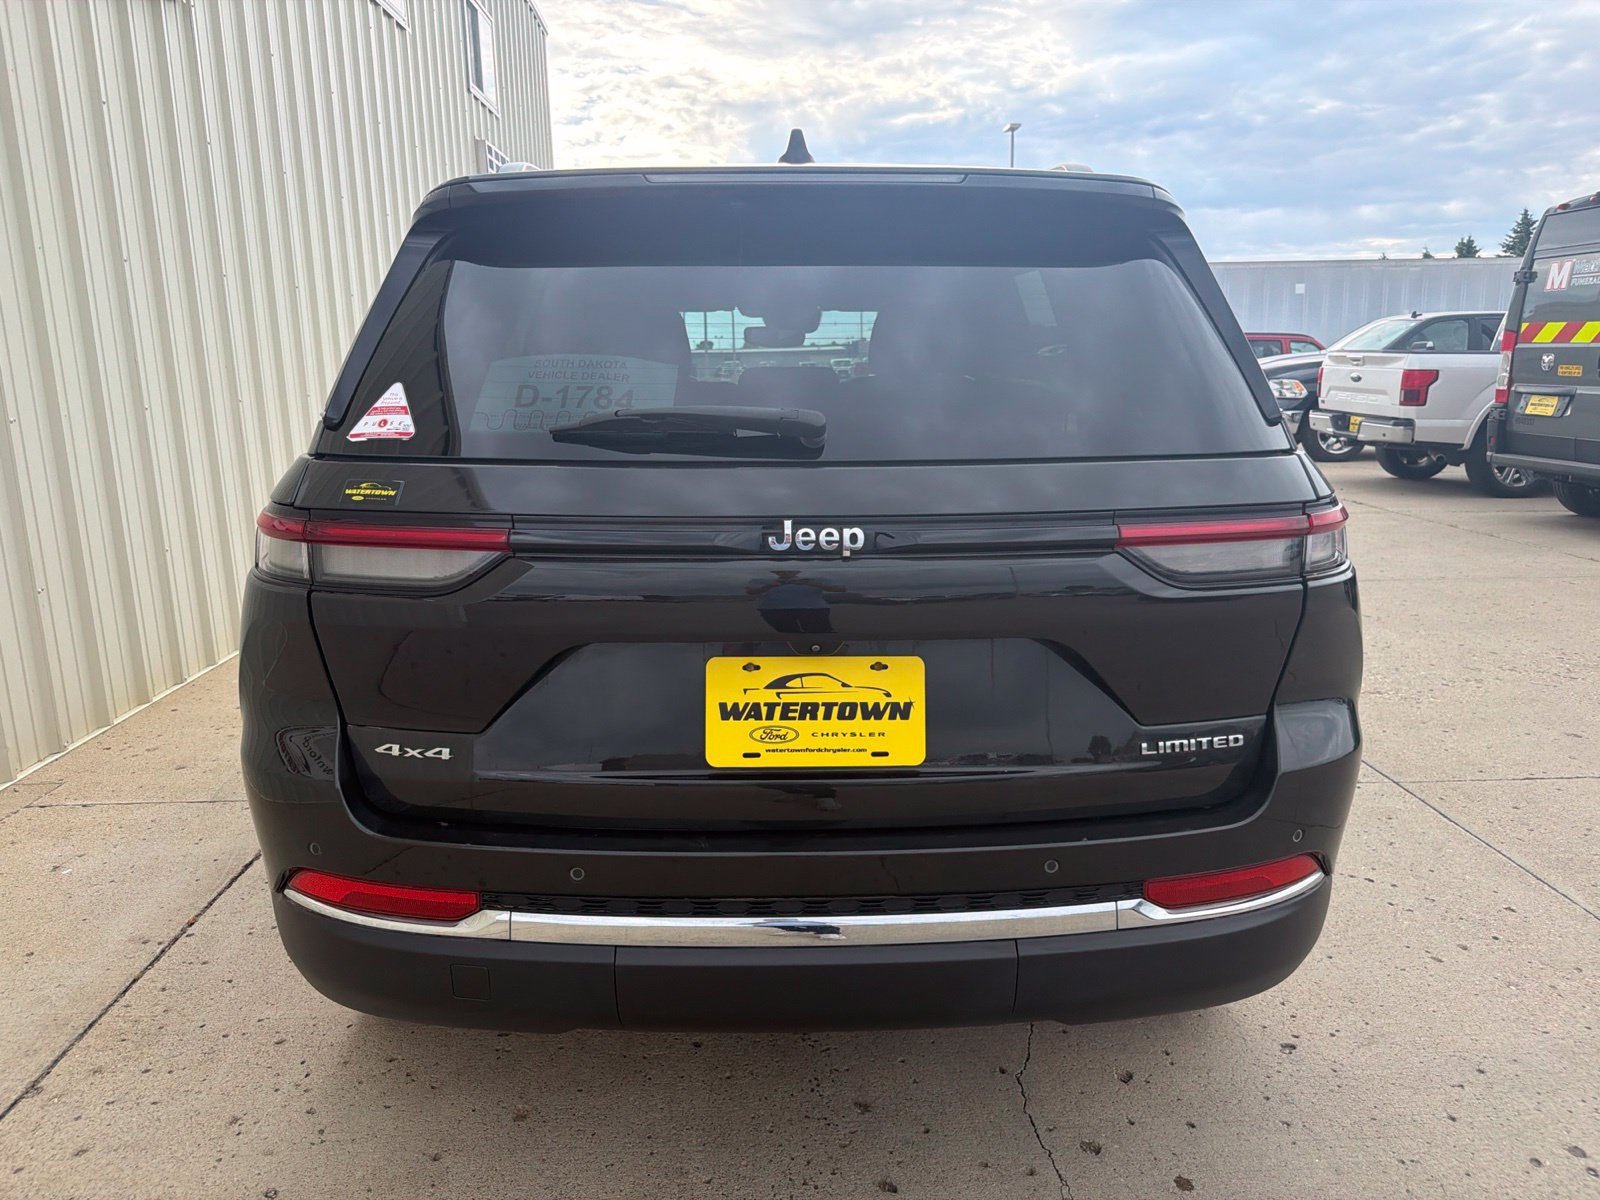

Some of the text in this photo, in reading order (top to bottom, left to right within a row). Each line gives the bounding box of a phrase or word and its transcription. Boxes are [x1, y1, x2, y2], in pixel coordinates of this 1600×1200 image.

[1544, 258, 1575, 292] M
[534, 359, 628, 370] SOUTH DAKOTA
[527, 370, 631, 383] VEHICLE DEALER
[513, 384, 636, 410] D-1784
[345, 488, 397, 496] WATERTOWN
[768, 519, 865, 557] Jeep
[718, 701, 913, 721] WATERTOWN
[374, 743, 454, 760] 4x4
[1141, 734, 1244, 755] LIMITED
